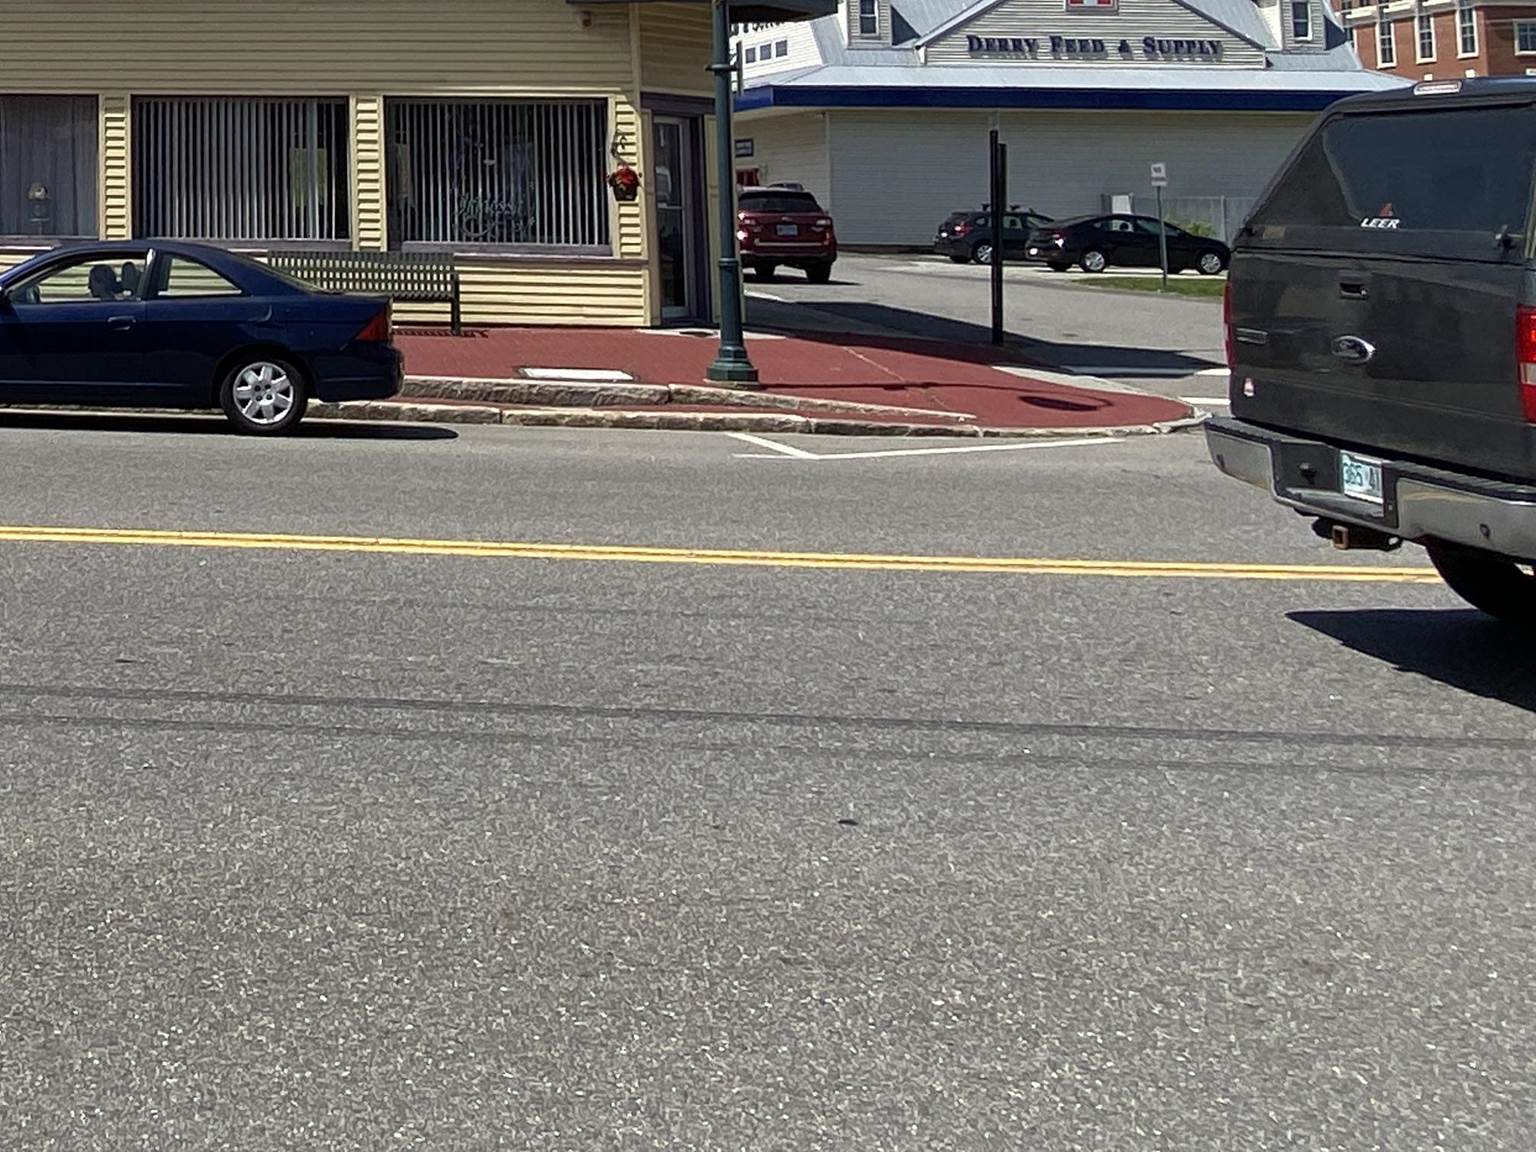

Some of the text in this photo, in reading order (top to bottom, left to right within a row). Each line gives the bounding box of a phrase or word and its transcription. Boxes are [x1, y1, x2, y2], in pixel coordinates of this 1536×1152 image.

[966, 35, 1040, 53] DERRY
[1049, 35, 1105, 53] FEED
[1143, 36, 1222, 55] SUPPLY
[1360, 217, 1401, 229] LEER
